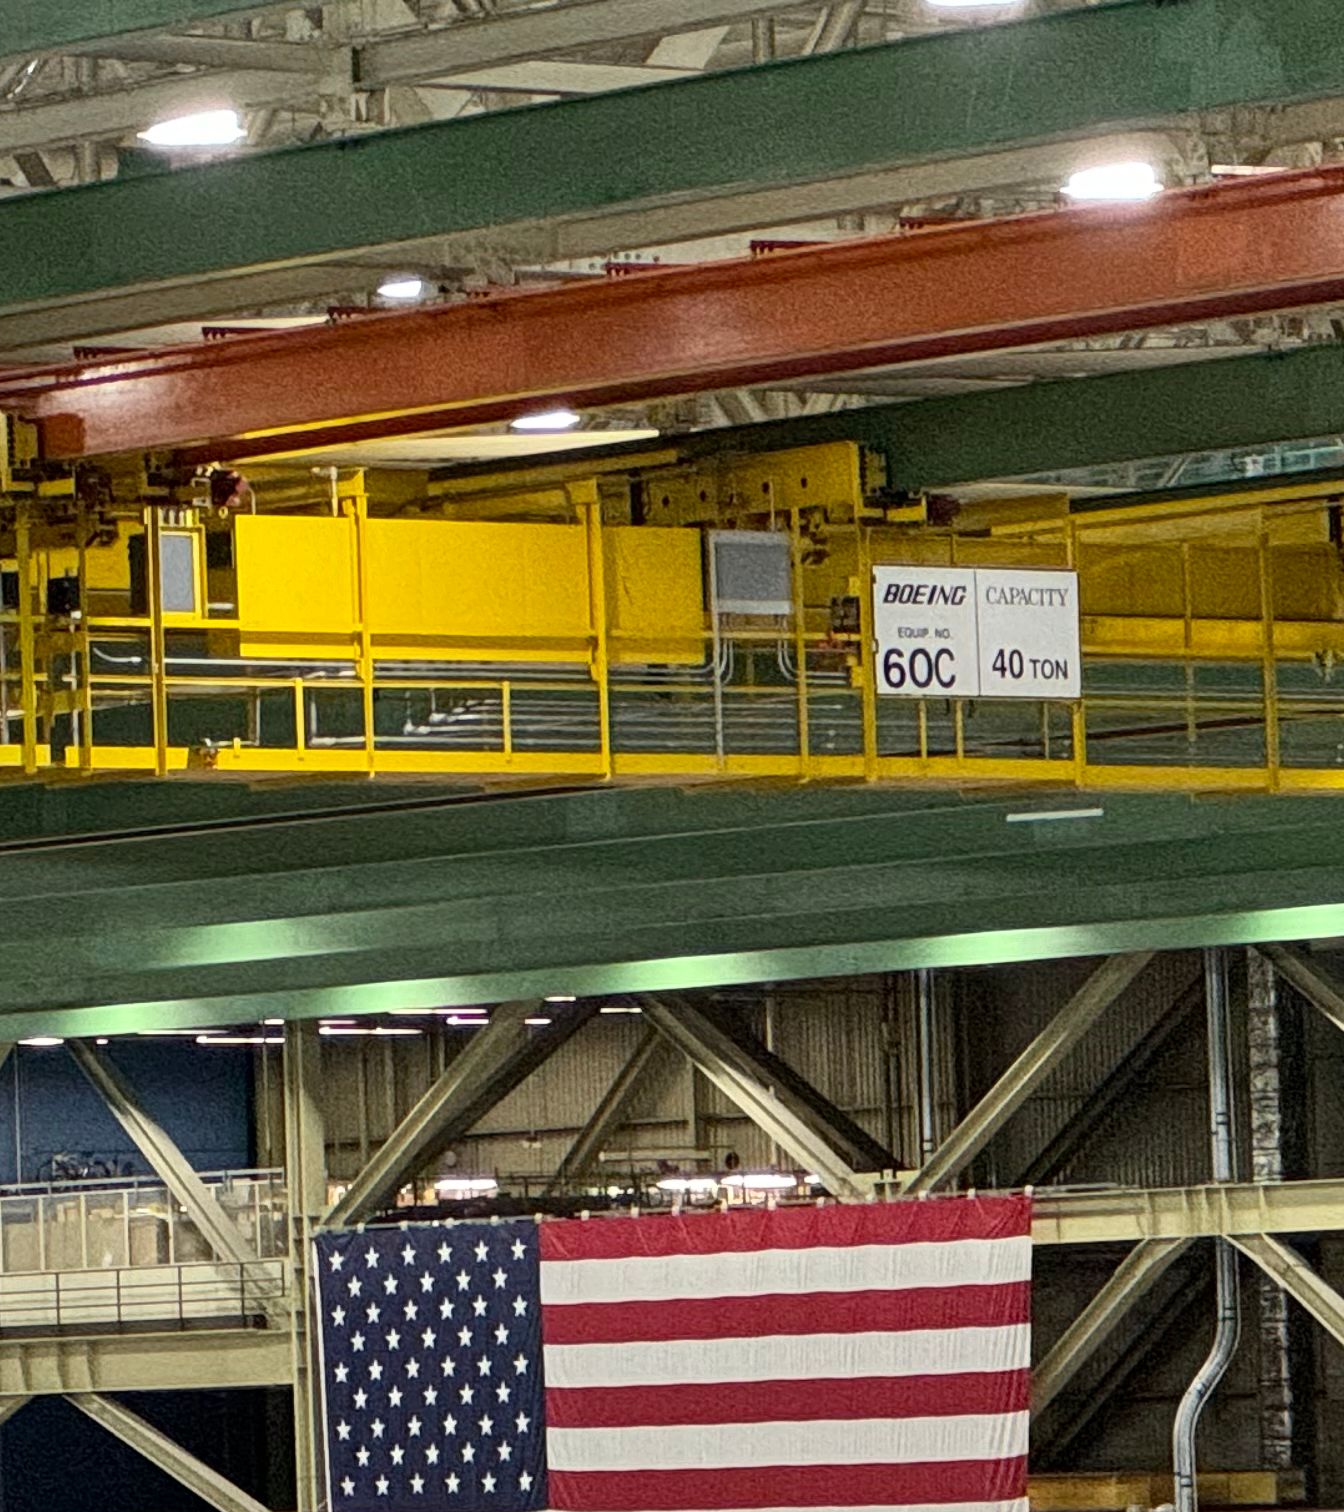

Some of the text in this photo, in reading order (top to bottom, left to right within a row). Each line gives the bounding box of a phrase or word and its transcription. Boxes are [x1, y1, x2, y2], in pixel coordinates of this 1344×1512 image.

[882, 583, 967, 606] BOEING
[985, 586, 1069, 606] CAPACITY
[883, 647, 956, 689] 60C
[992, 648, 1069, 680] 40 TON
